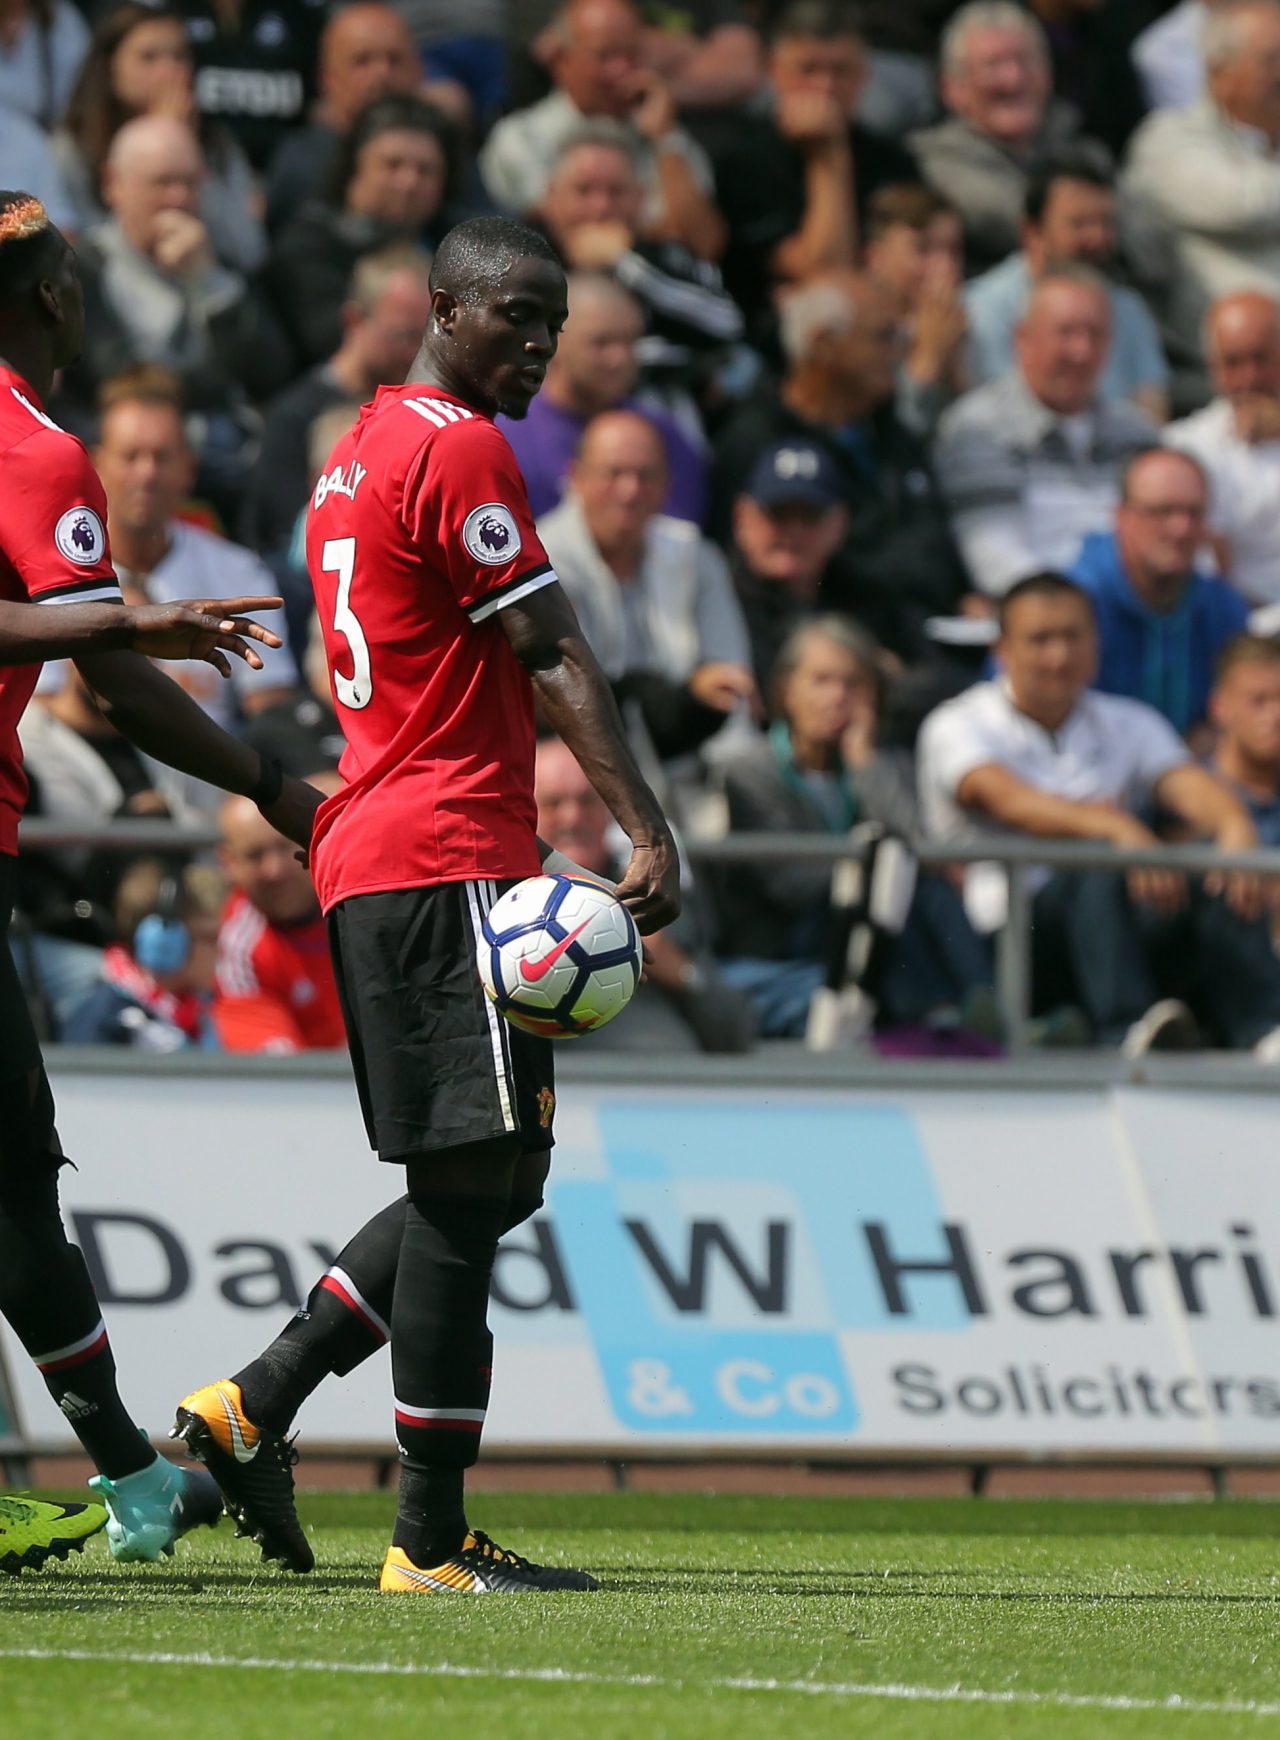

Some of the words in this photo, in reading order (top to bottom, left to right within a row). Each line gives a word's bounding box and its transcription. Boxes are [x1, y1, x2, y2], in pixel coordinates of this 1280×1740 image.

[321, 536, 373, 711] 3
[70, 1211, 582, 1322] Dad
[623, 1218, 791, 1315] W
[627, 1358, 695, 1417] &
[714, 1359, 840, 1418] Co
[891, 1362, 1280, 1421] Solicitors
